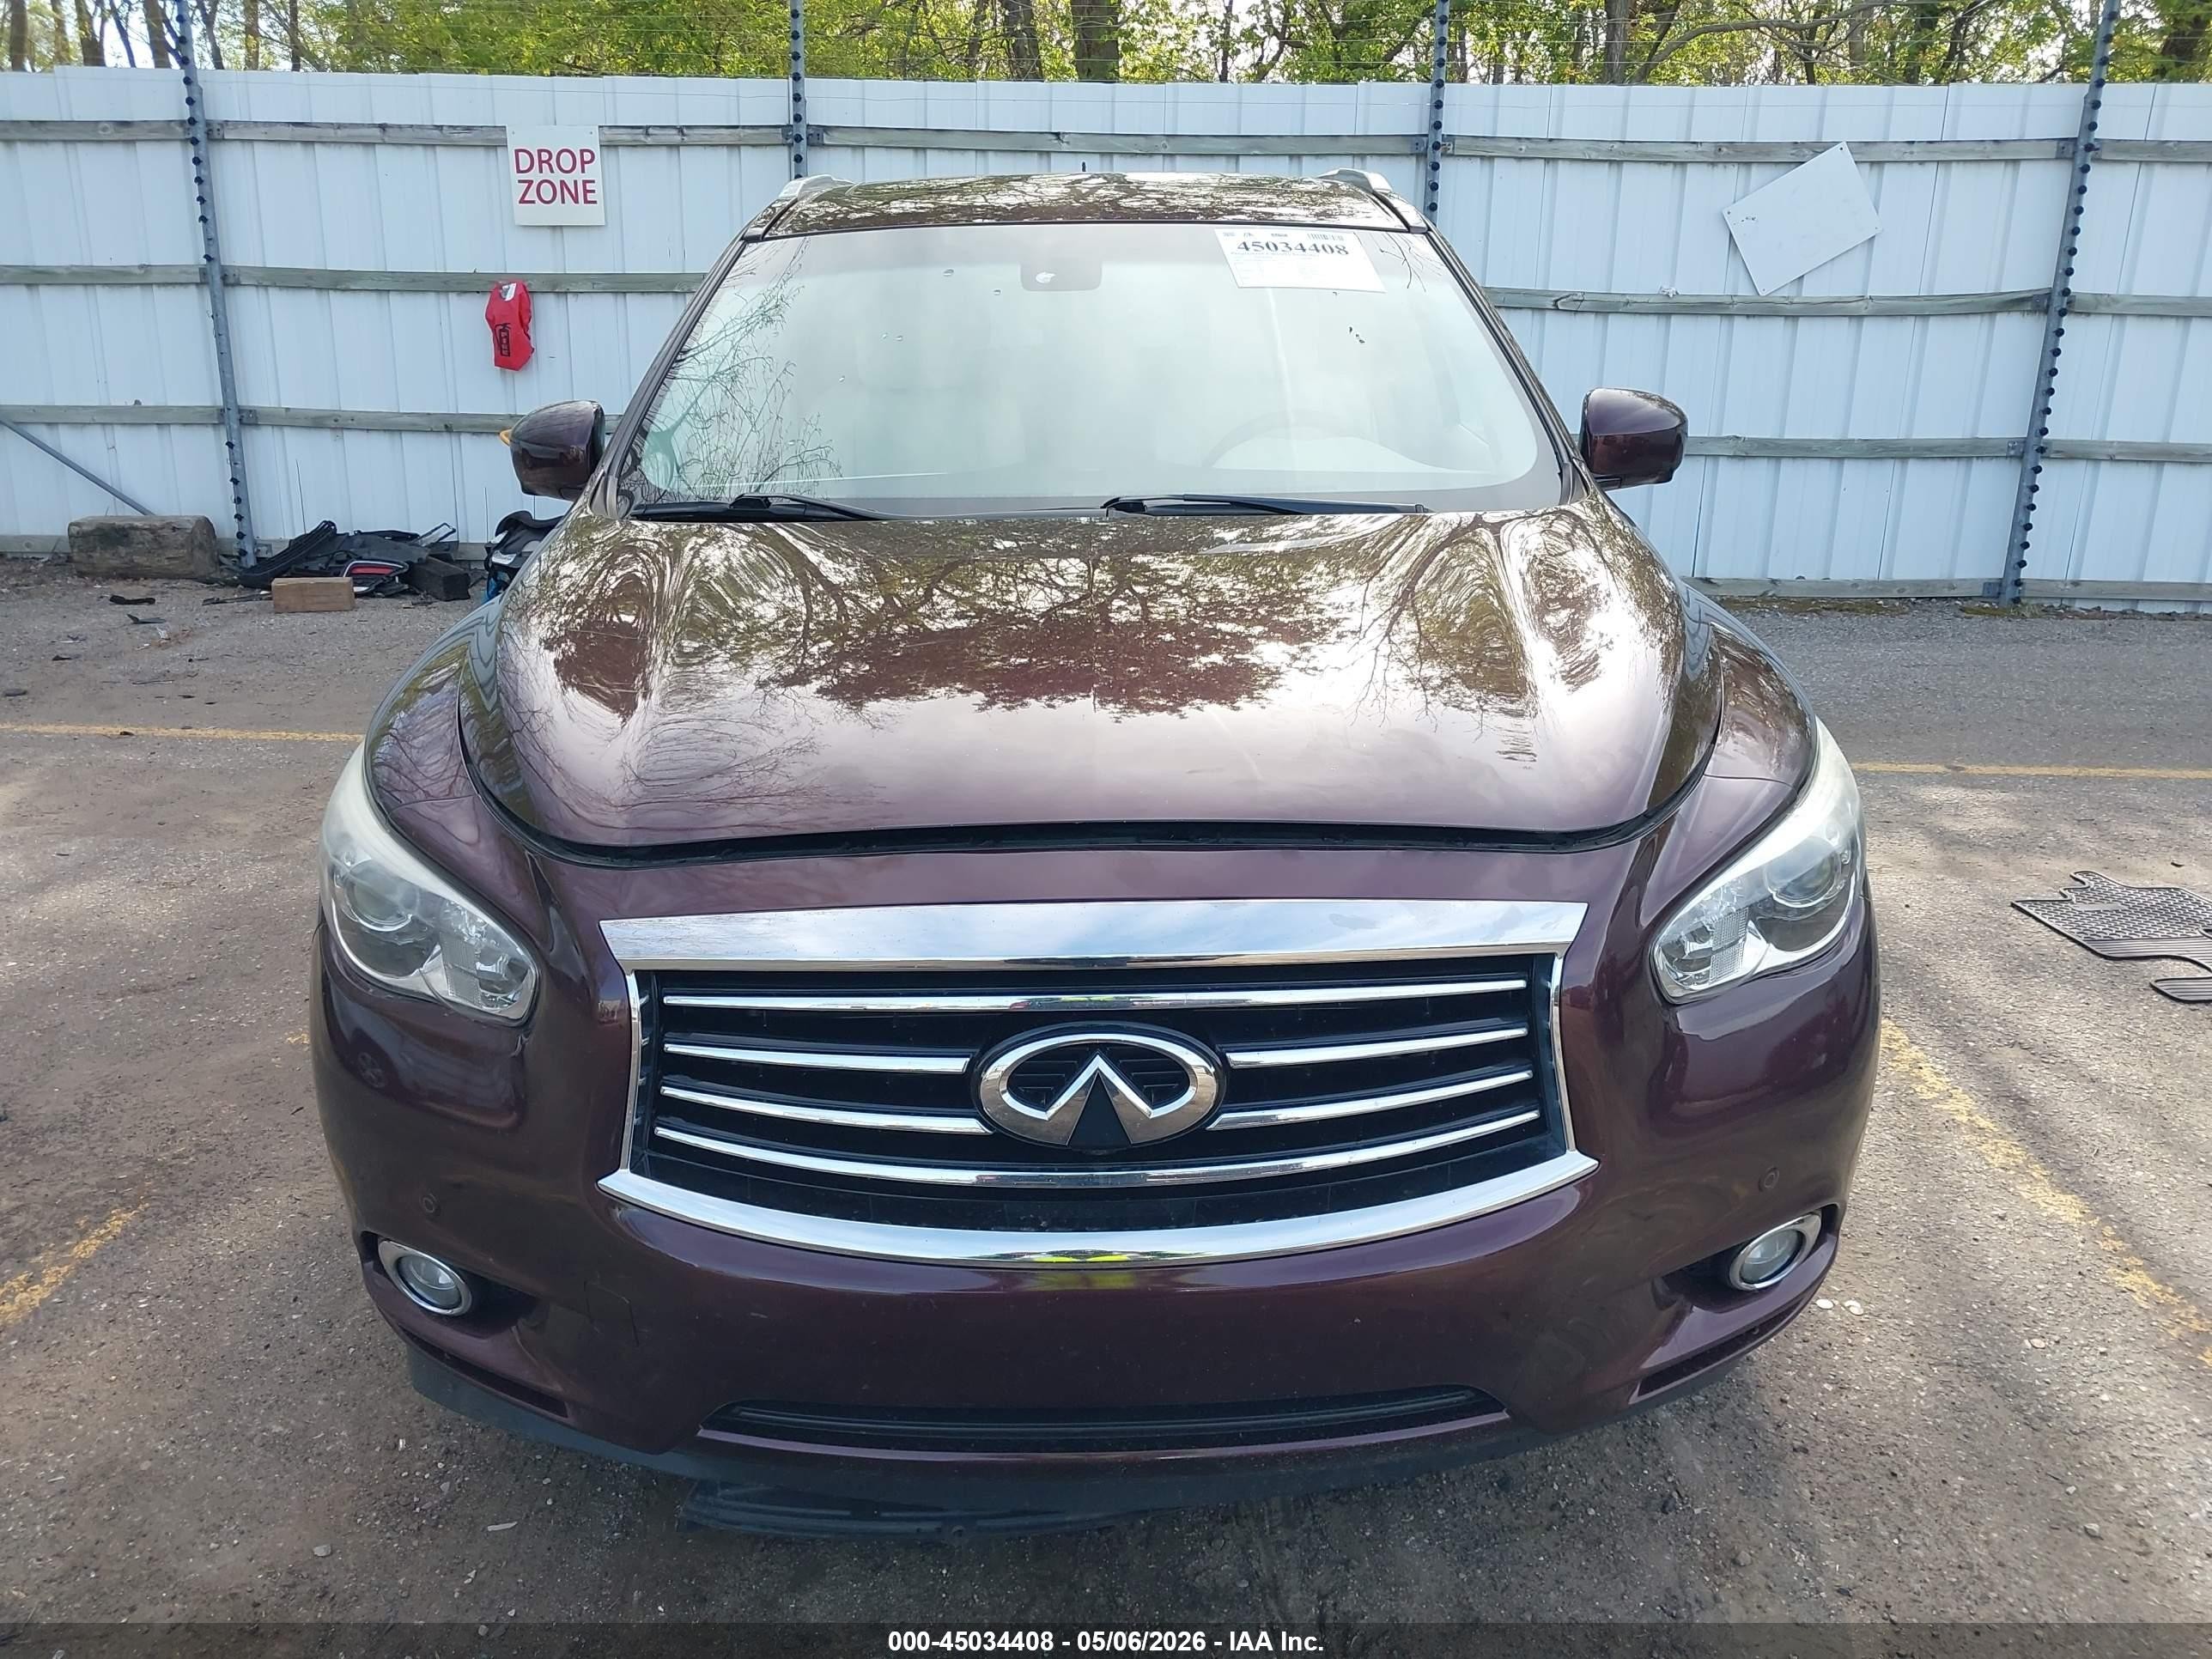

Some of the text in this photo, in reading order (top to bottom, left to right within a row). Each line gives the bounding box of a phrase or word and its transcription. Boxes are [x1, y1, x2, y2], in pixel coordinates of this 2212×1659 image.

[514, 149, 596, 174] DROP
[518, 179, 598, 204] ZONE
[1237, 240, 1349, 255] 45034408
